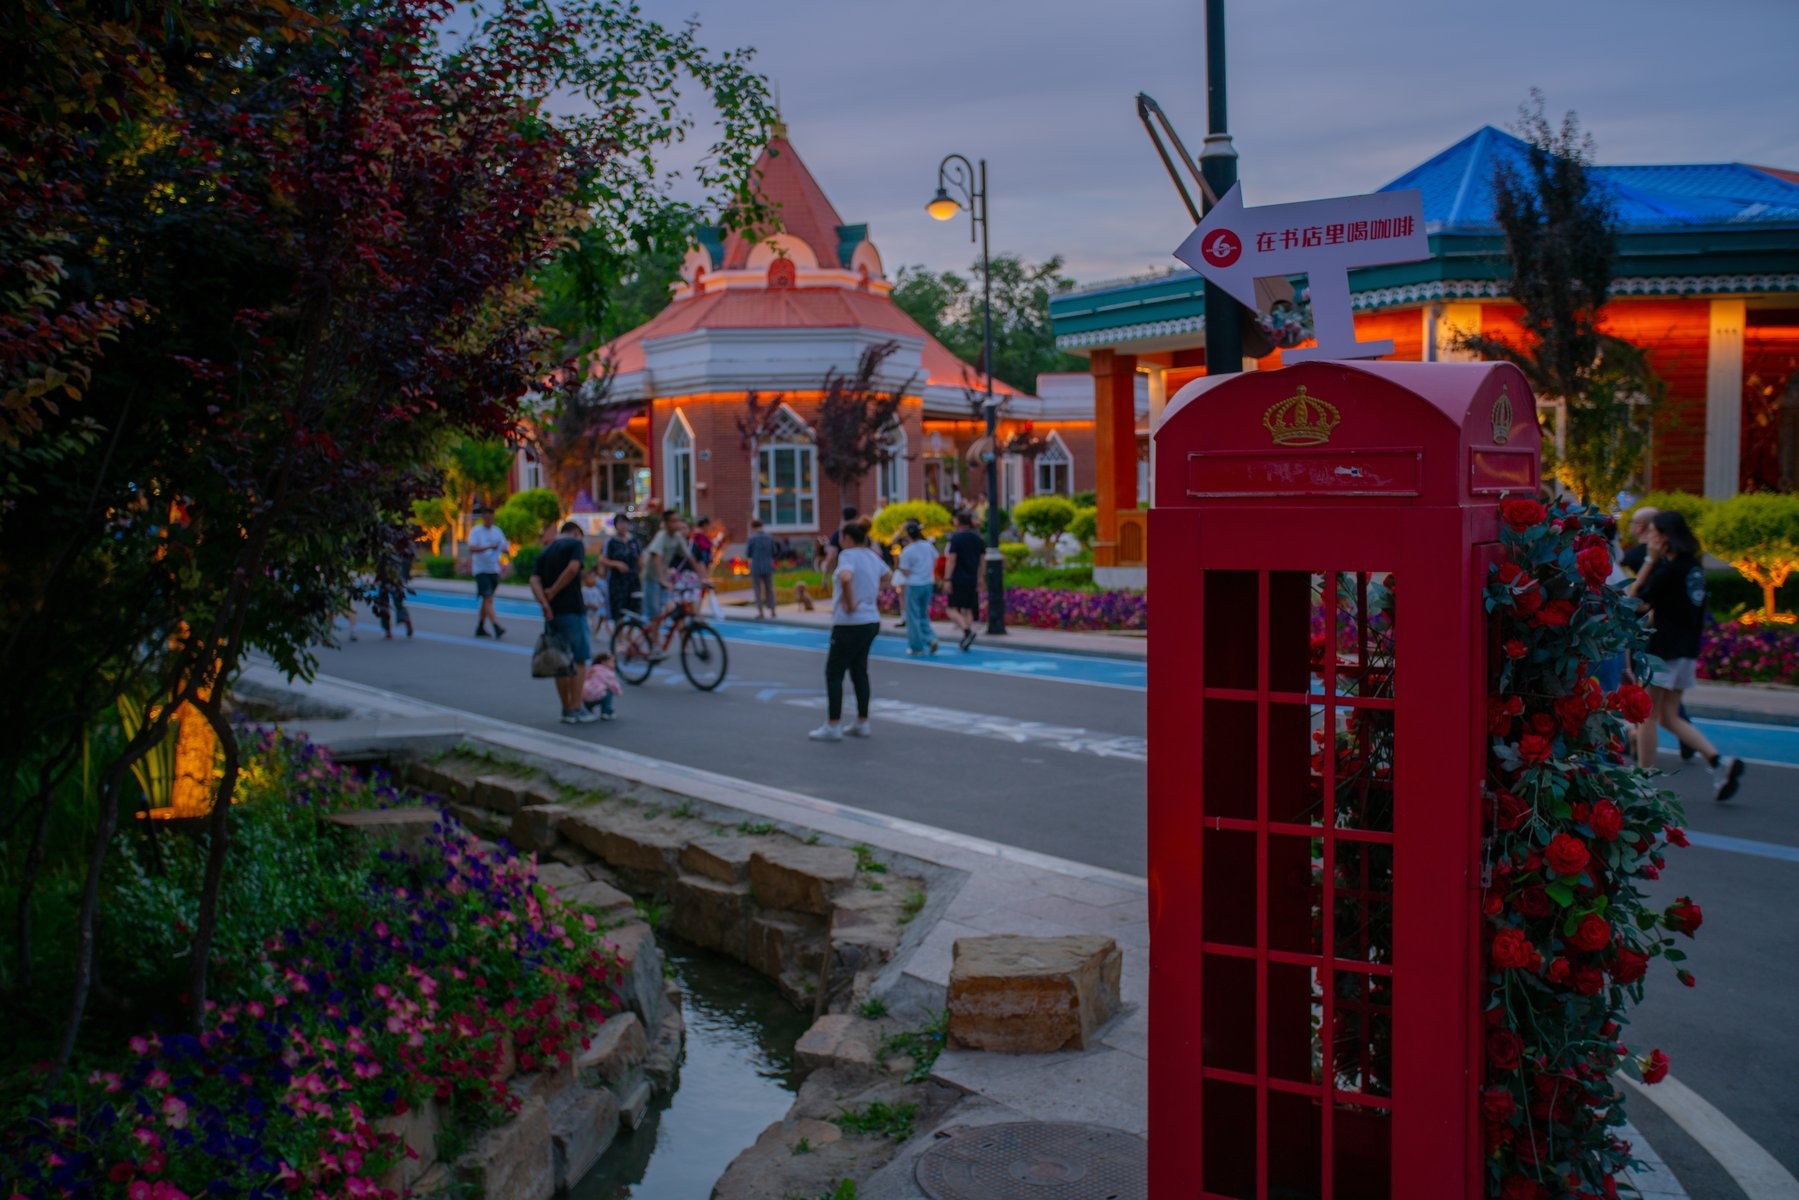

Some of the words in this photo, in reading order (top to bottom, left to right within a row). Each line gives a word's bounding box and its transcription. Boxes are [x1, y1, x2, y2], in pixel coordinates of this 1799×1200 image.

[1256, 215, 1415, 252] 在书店里喝咖啡
